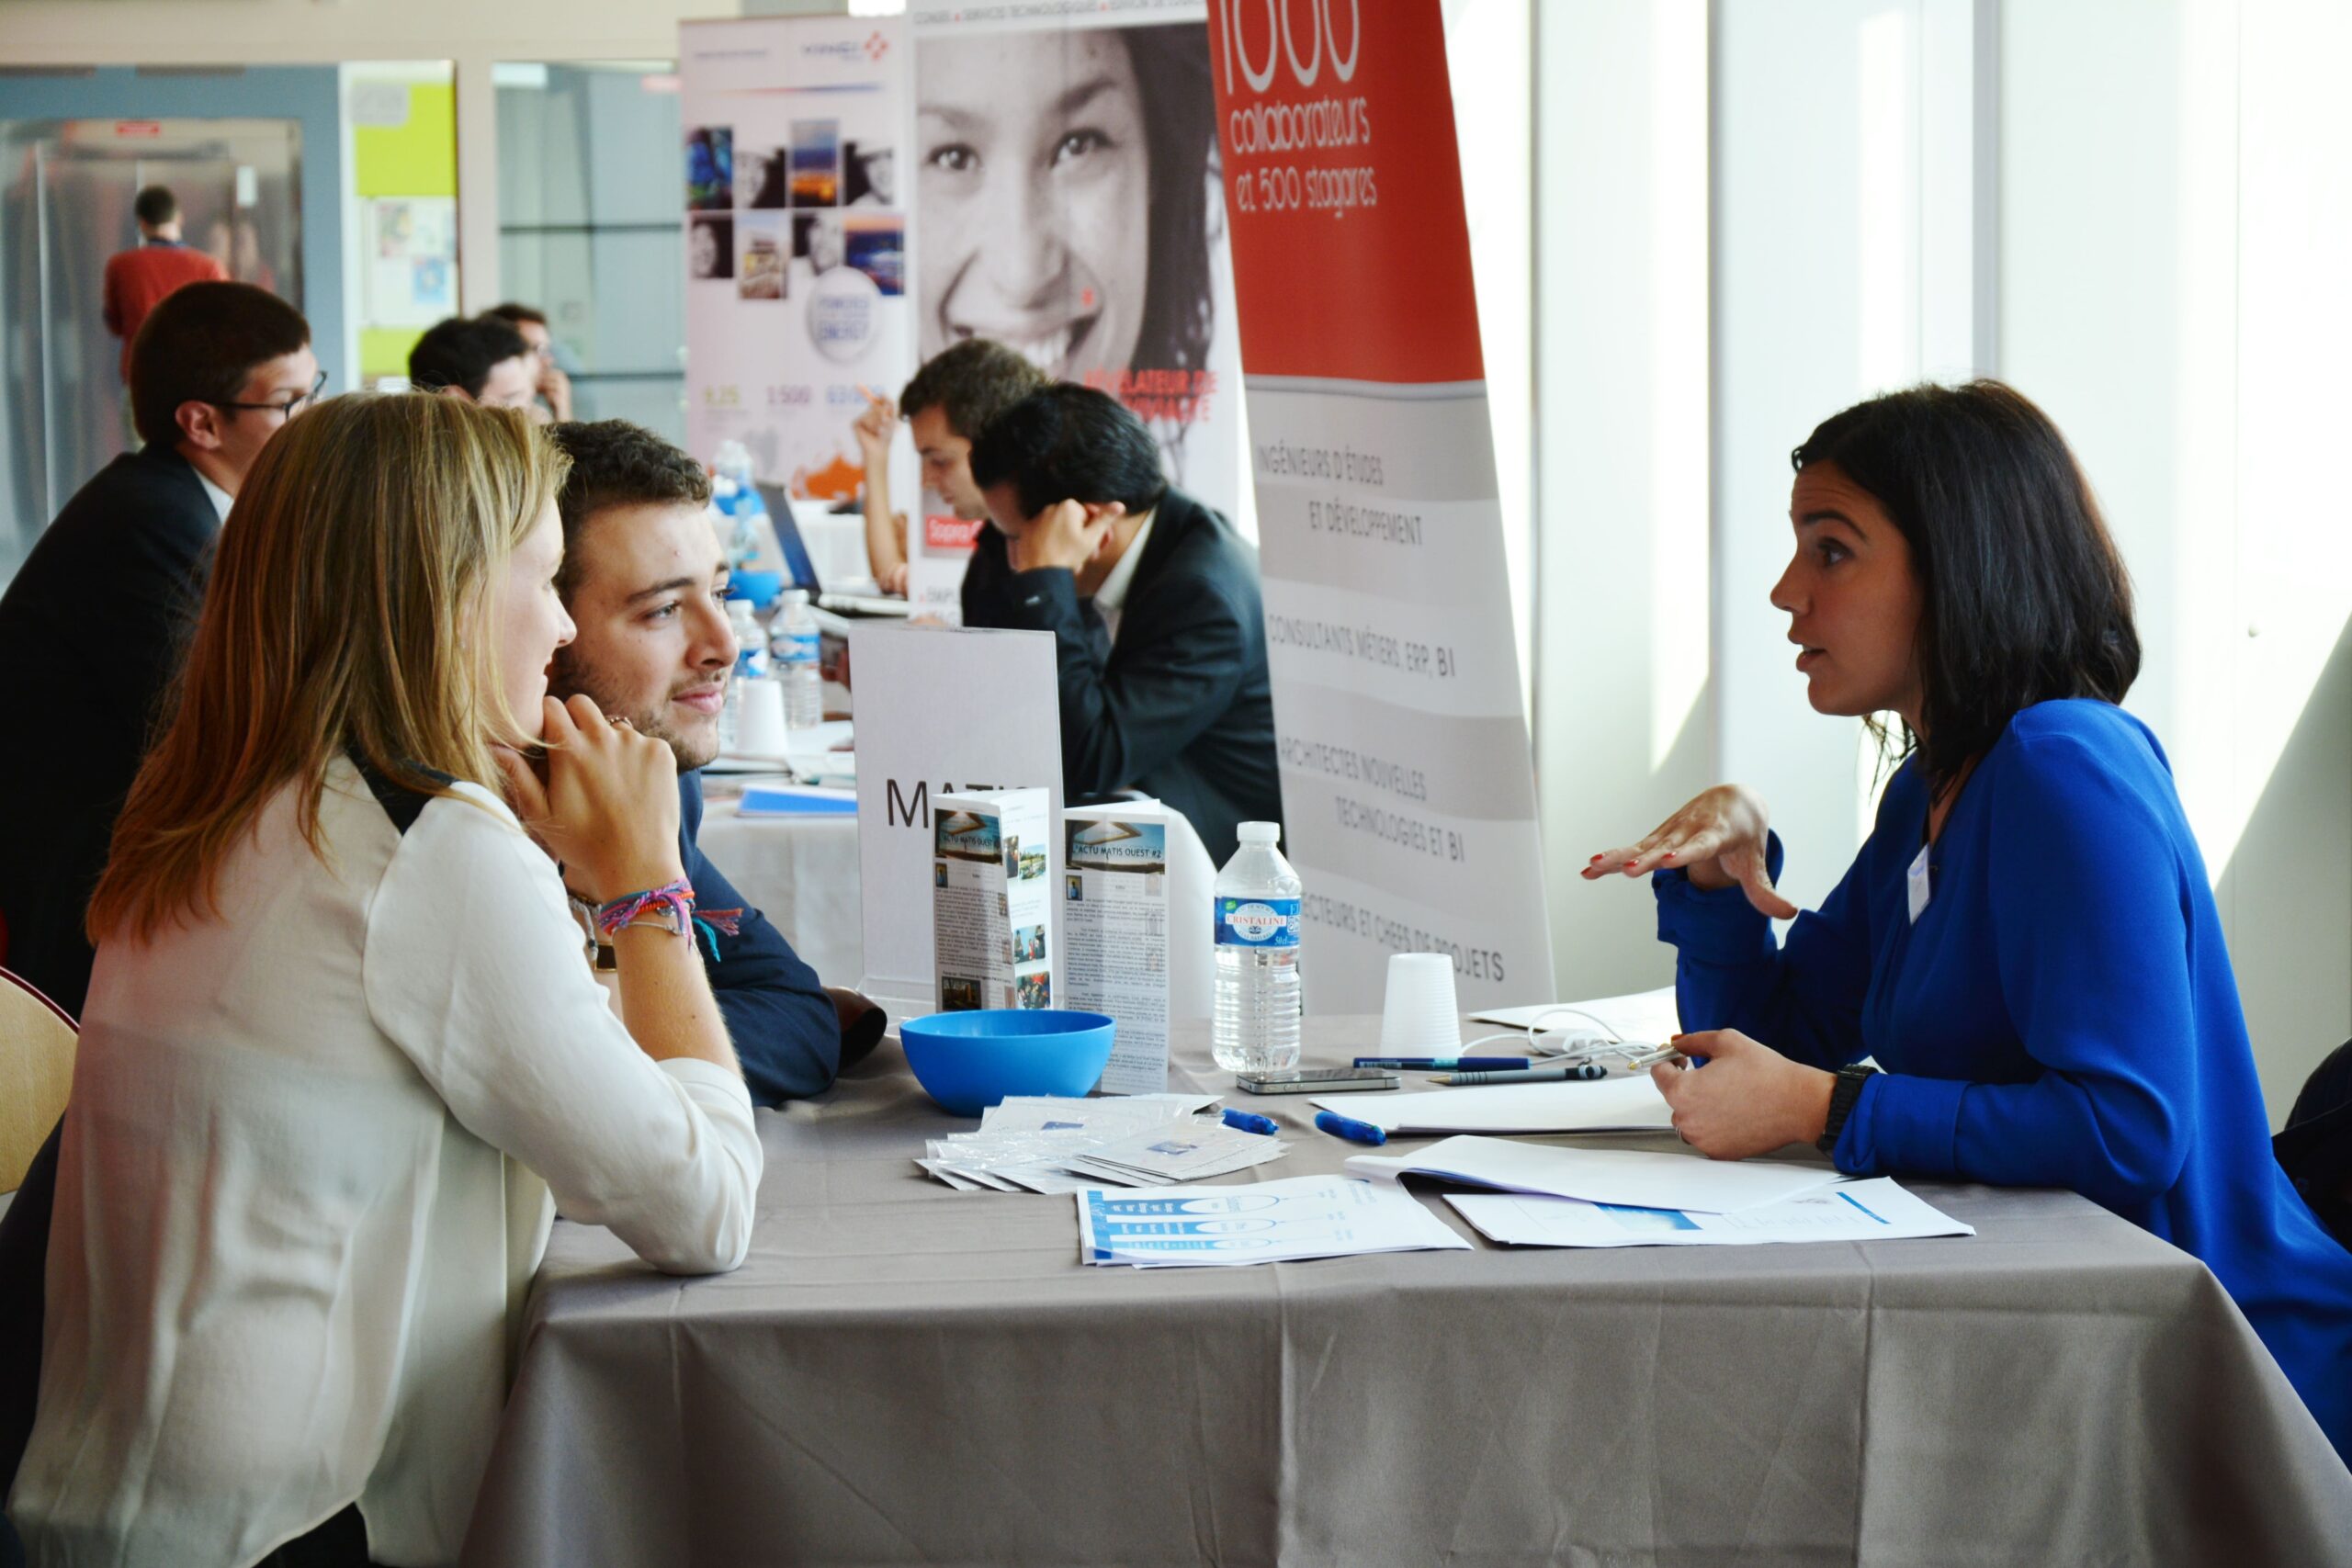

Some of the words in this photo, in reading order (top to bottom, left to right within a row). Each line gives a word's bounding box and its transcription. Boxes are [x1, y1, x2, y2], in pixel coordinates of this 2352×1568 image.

[1229, 95, 1371, 154] collaborateurs
[1236, 168, 1257, 211] et
[1259, 165, 1302, 211] 500
[1309, 500, 1322, 530] ET
[1326, 496, 1422, 545] DÉVELOPPEMENT
[1269, 614, 1353, 657] CONSULTANTS
[1437, 646, 1456, 678] BI
[1361, 753, 1427, 802] NOUVELLES
[1101, 847, 1122, 856] MATIS
[1125, 848, 1149, 857] OUEST
[1152, 850, 1161, 859] #2
[1335, 795, 1427, 852] TECHNOLOGIES
[1429, 825, 1443, 857] ET
[1448, 830, 1465, 863] BI
[1227, 913, 1285, 926] CRISTALINE
[1300, 892, 1357, 933] ECTEURS
[1359, 907, 1373, 938] ET
[1374, 915, 1412, 953] CHEFS
